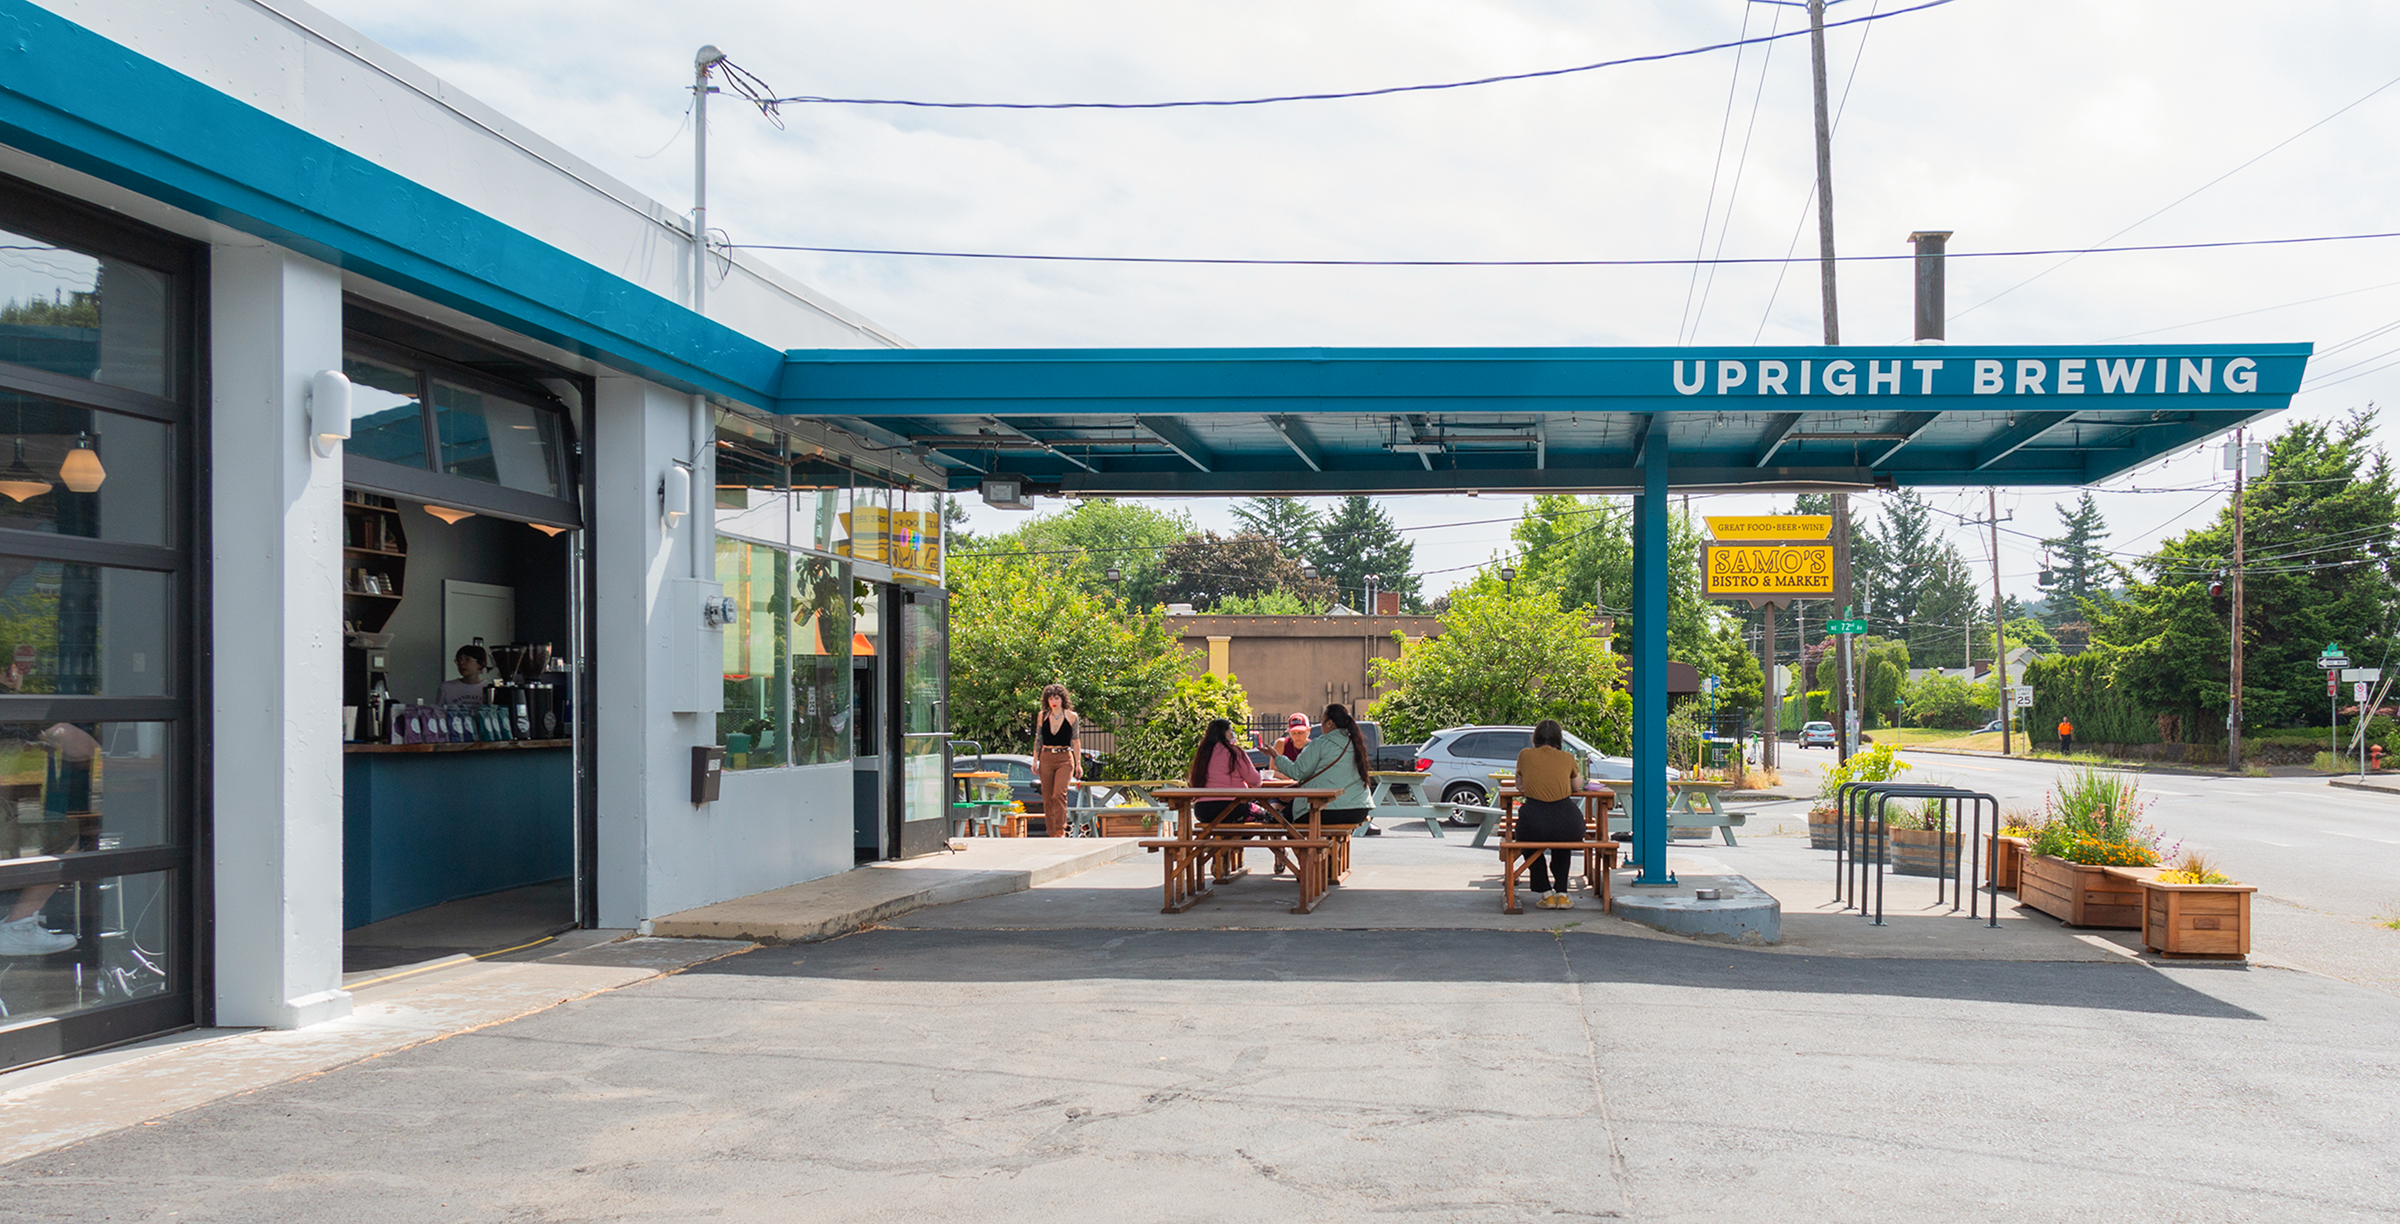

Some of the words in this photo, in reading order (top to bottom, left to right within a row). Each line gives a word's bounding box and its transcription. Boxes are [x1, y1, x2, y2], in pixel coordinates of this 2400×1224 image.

[1673, 360, 1943, 395] UPRIGHT
[1973, 357, 2257, 394] BREWING
[900, 527, 920, 551] OPEN
[1715, 550, 1826, 574] SAMO'S
[1712, 576, 1759, 587] BISTRO
[1763, 576, 1771, 587] &
[1775, 576, 1829, 587] MARKET
[2017, 696, 2031, 704] 25
